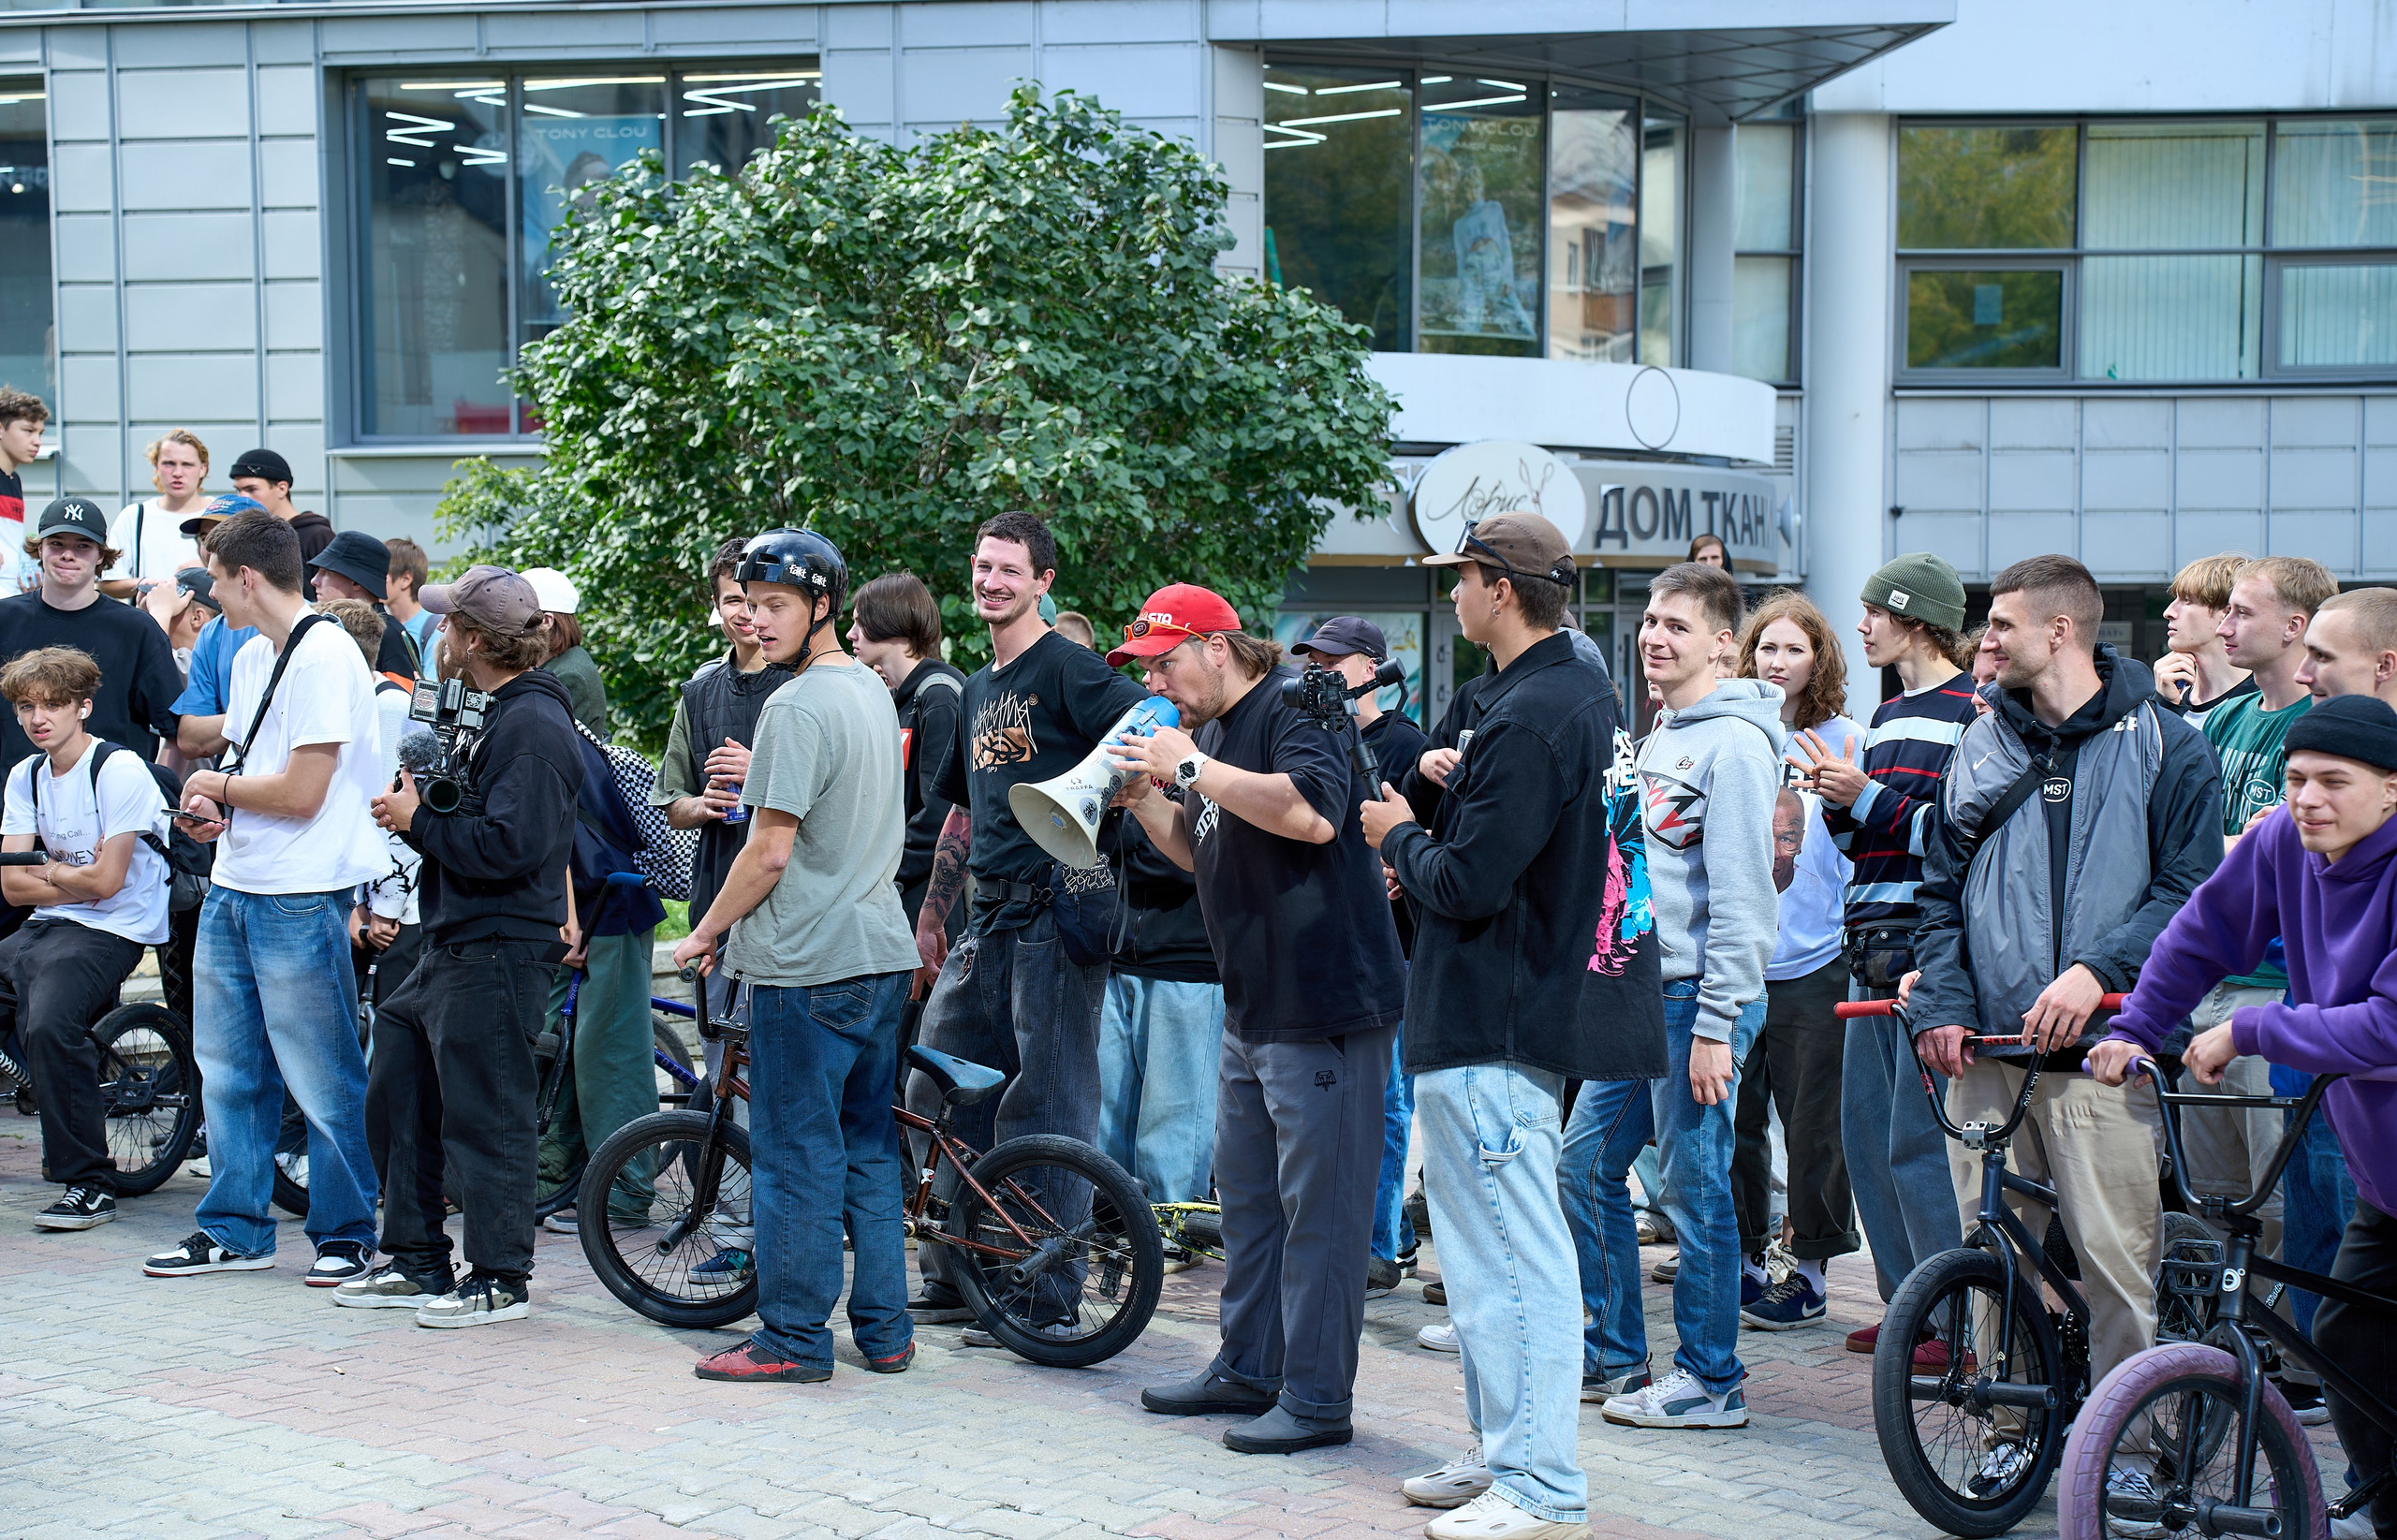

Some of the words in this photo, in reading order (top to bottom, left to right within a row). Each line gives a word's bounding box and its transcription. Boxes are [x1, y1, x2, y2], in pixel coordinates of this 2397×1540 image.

[535, 127, 588, 140] TONY
[593, 126, 648, 139] CLOU
[1483, 121, 1537, 138] CLOU
[1595, 484, 1692, 550] ДОМ
[2043, 783, 2068, 796] MST
[2249, 784, 2272, 800] MST
